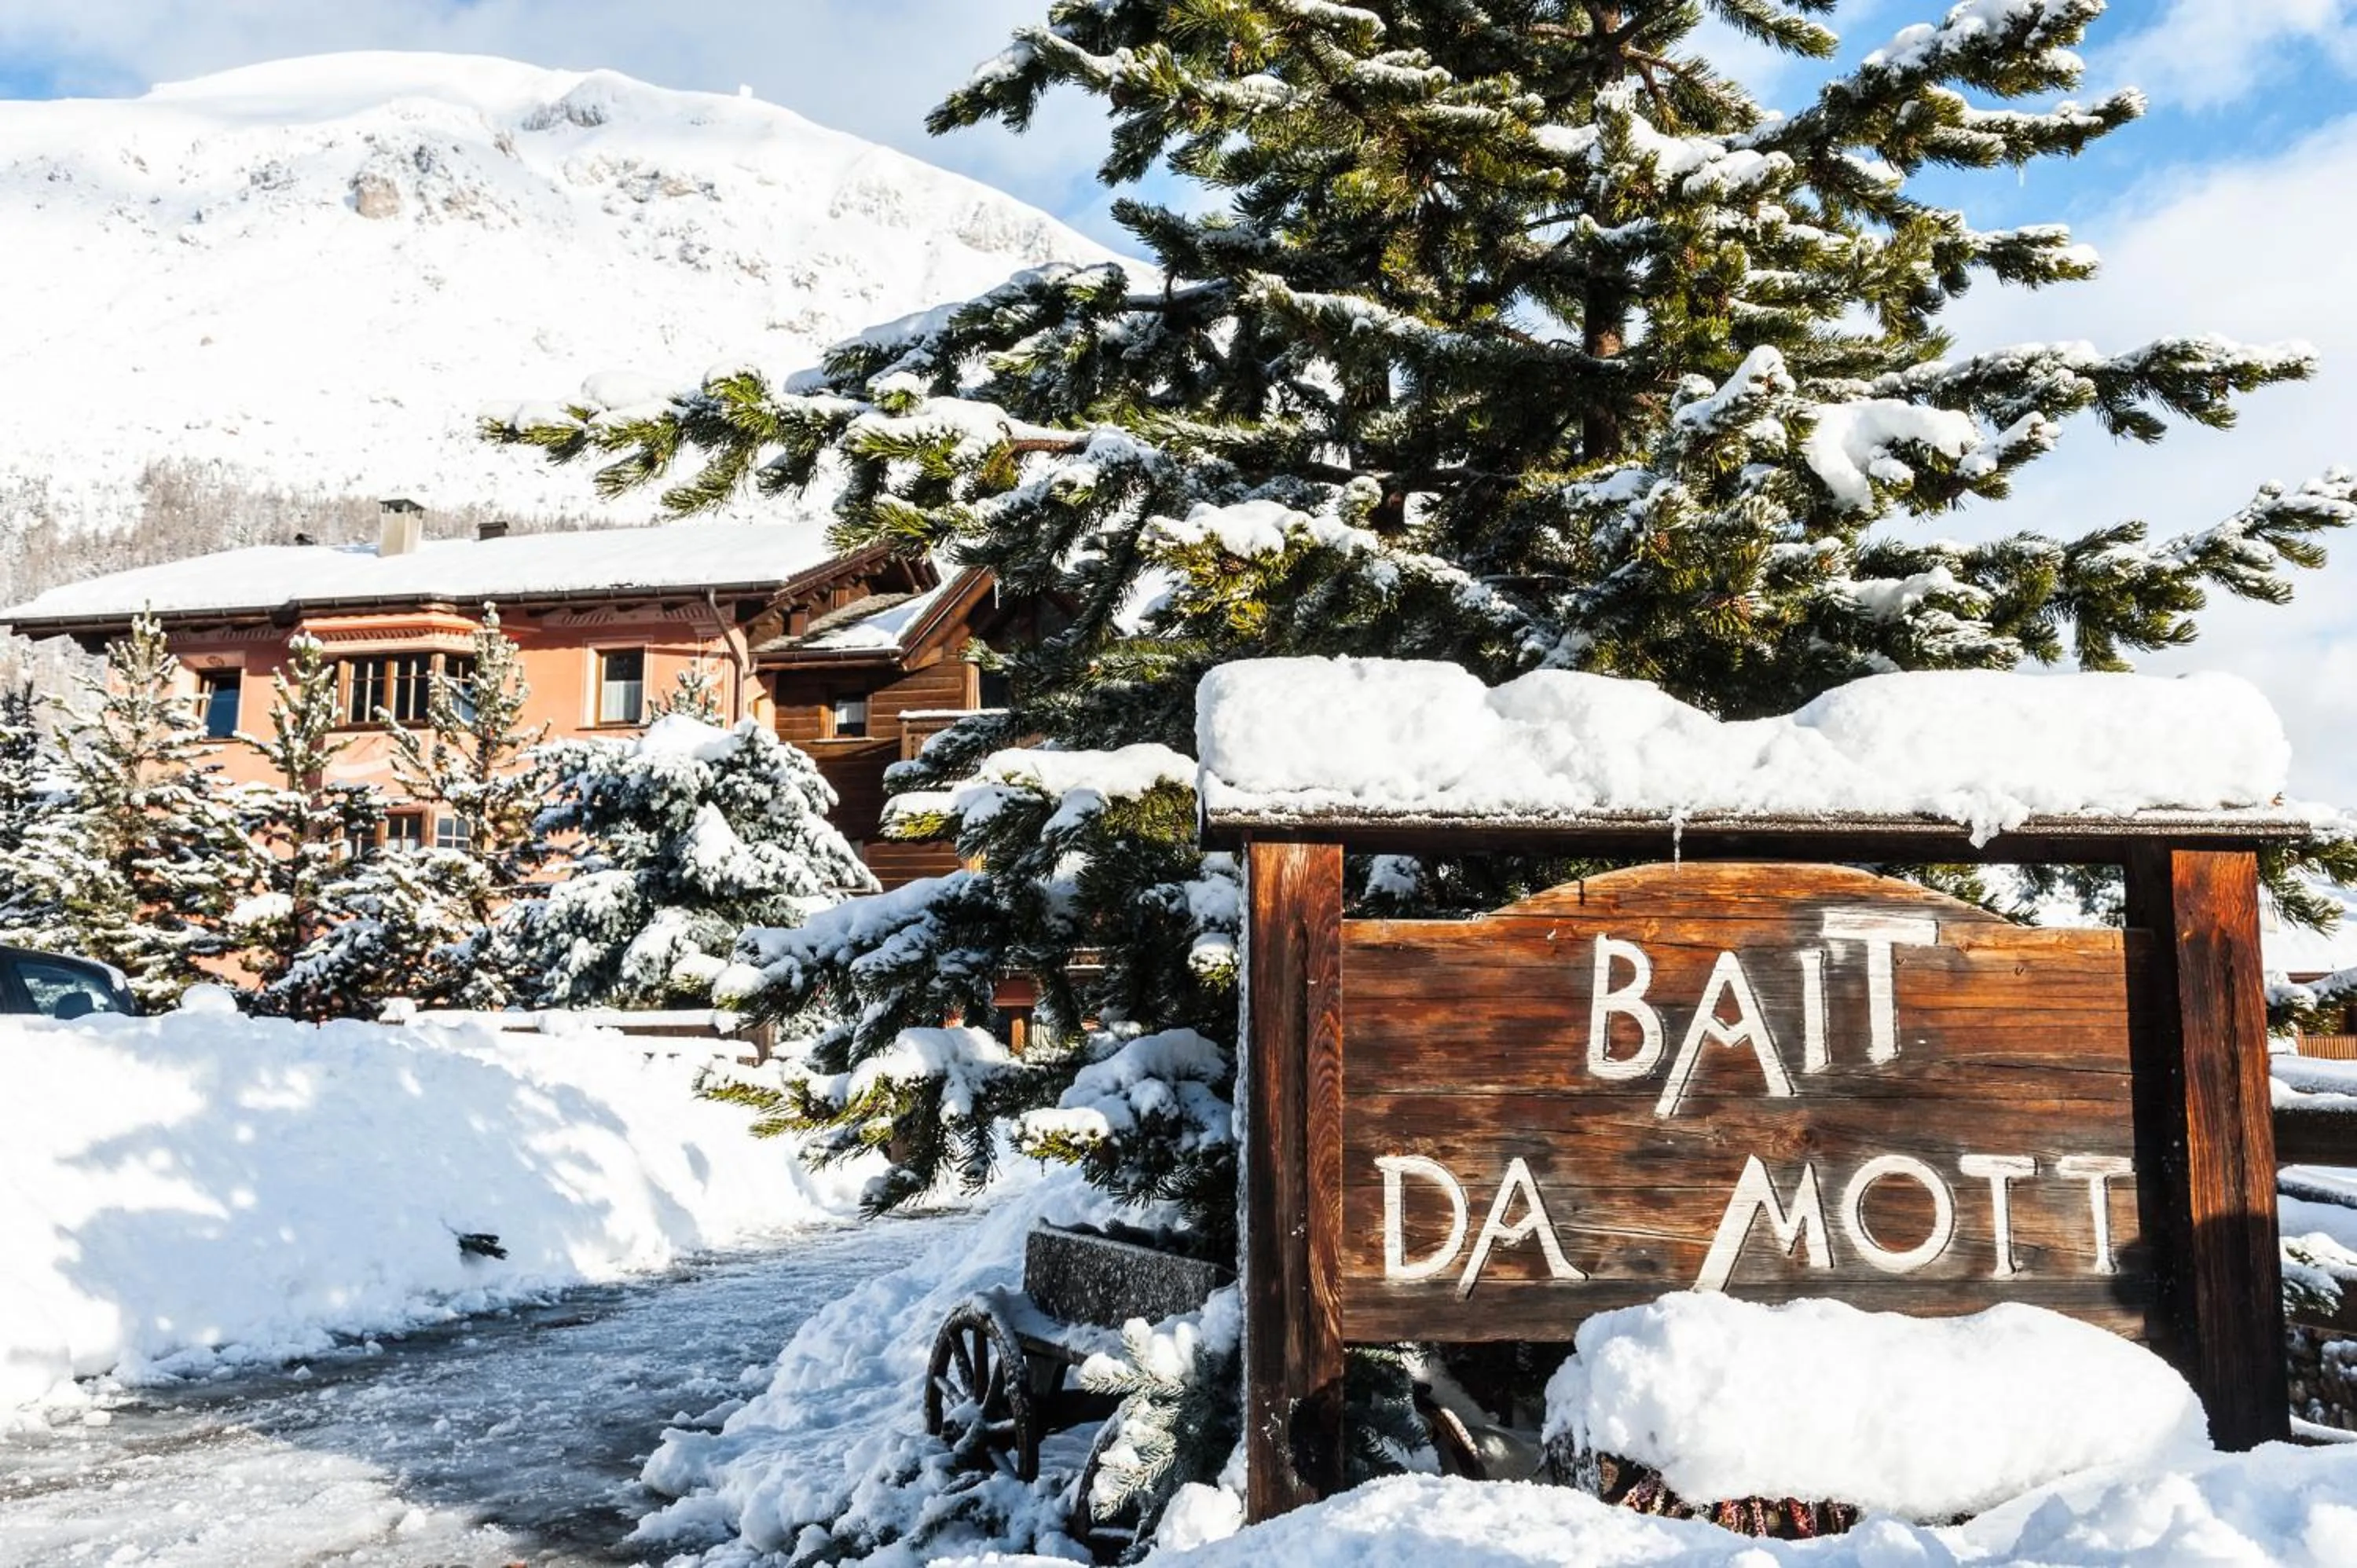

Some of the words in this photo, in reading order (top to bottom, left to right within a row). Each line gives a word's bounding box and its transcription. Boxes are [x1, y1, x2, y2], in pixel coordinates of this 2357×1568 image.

[1587, 910, 1939, 1118] BAIT
[1374, 1156, 1589, 1301] DA
[1692, 1154, 2135, 1292] MOTT
